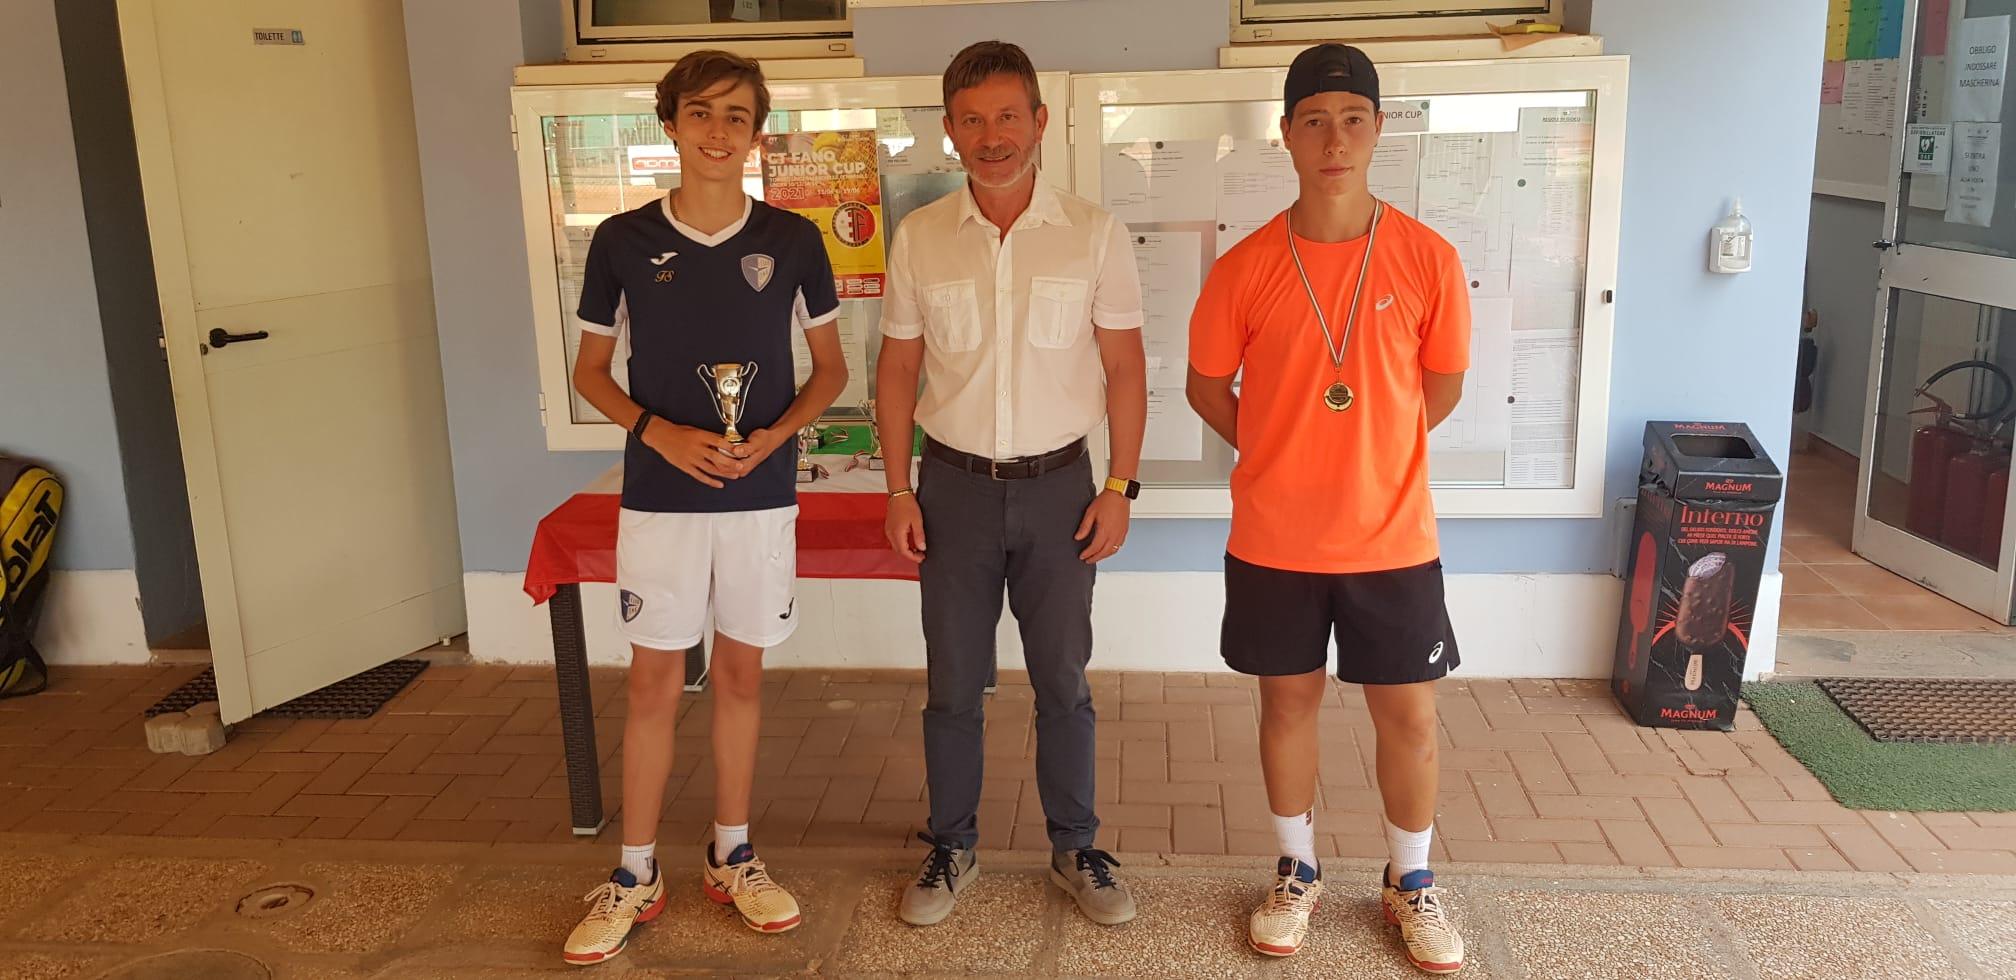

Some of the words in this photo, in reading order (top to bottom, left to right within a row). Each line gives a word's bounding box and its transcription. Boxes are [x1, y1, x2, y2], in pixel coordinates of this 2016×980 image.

[255, 32, 284, 41] TOILETTE
[1969, 45, 1997, 55] OBBLIGO
[1965, 62, 1997, 71] INDOSSARE
[1960, 79, 2000, 88] MASCHERINA
[1384, 111, 1403, 119] NIOR
[1405, 110, 1422, 119] CUP
[791, 150, 836, 164] FANO
[769, 164, 829, 177] JUNIOR
[833, 161, 866, 175] CUP
[771, 187, 805, 200] 2021
[1705, 482, 1752, 491] MAGNUM
[6, 489, 58, 594] olat
[1660, 708, 1717, 719] MAGNUM
